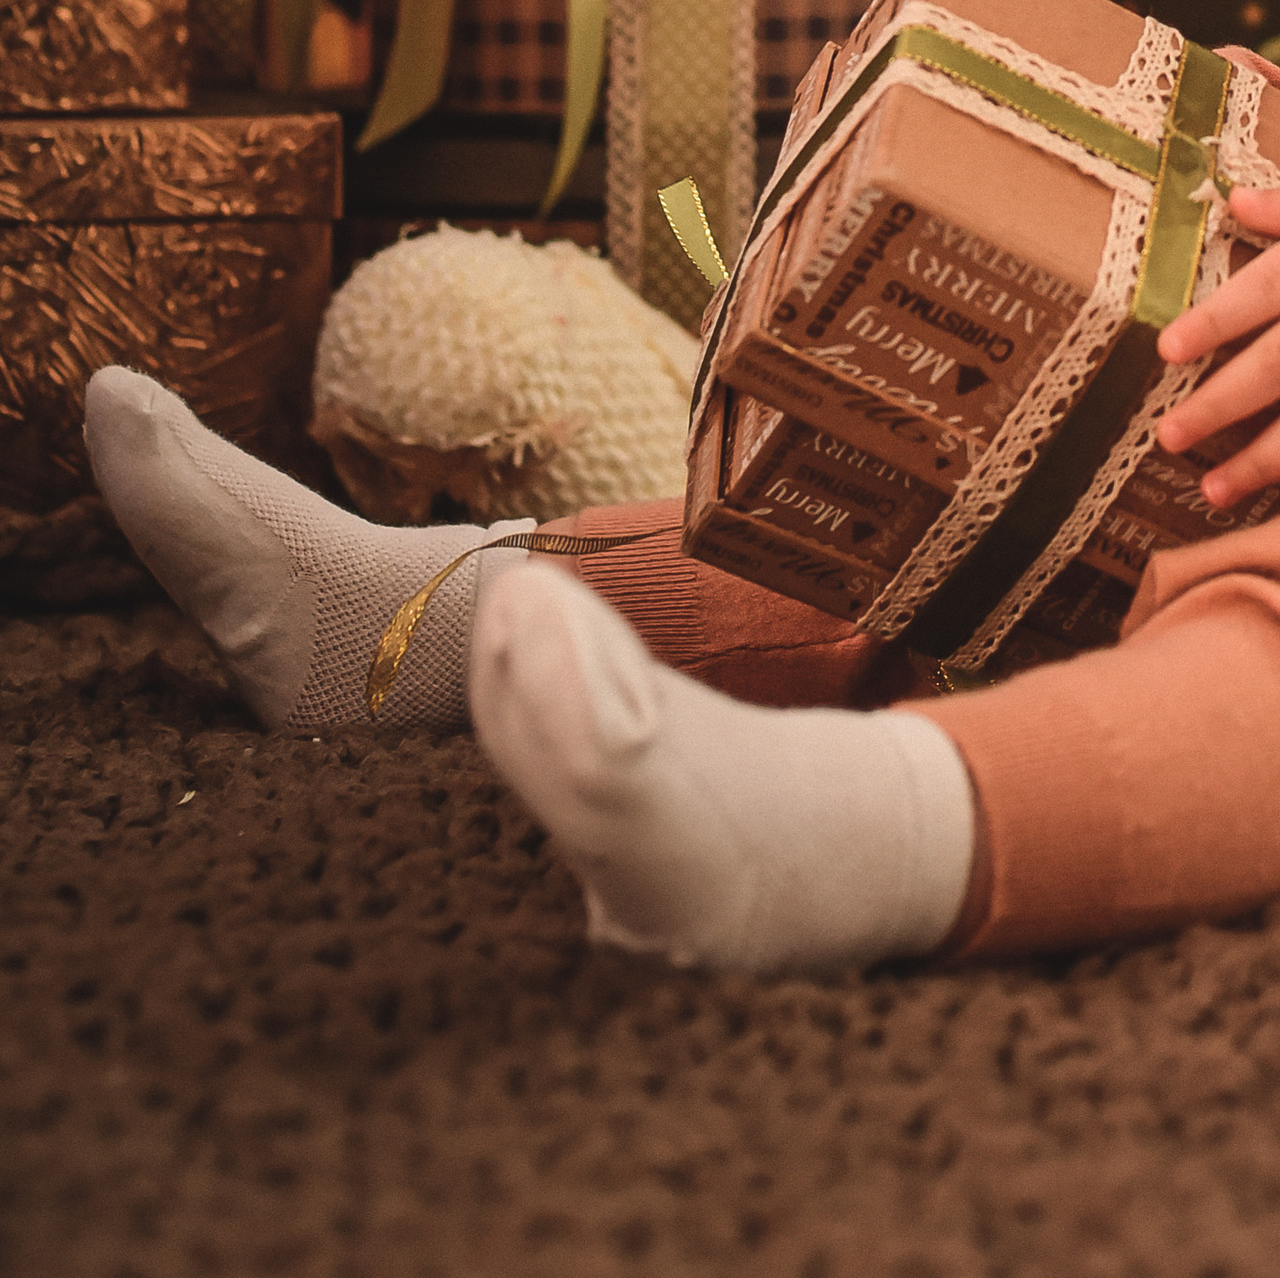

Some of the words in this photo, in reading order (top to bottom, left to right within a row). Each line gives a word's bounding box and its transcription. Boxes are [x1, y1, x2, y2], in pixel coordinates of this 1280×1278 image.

[878, 277, 1015, 361] CHRISTMAS
[889, 246, 1045, 331] MERRY
[843, 305, 957, 385] Merry
[765, 477, 850, 532] Merry
